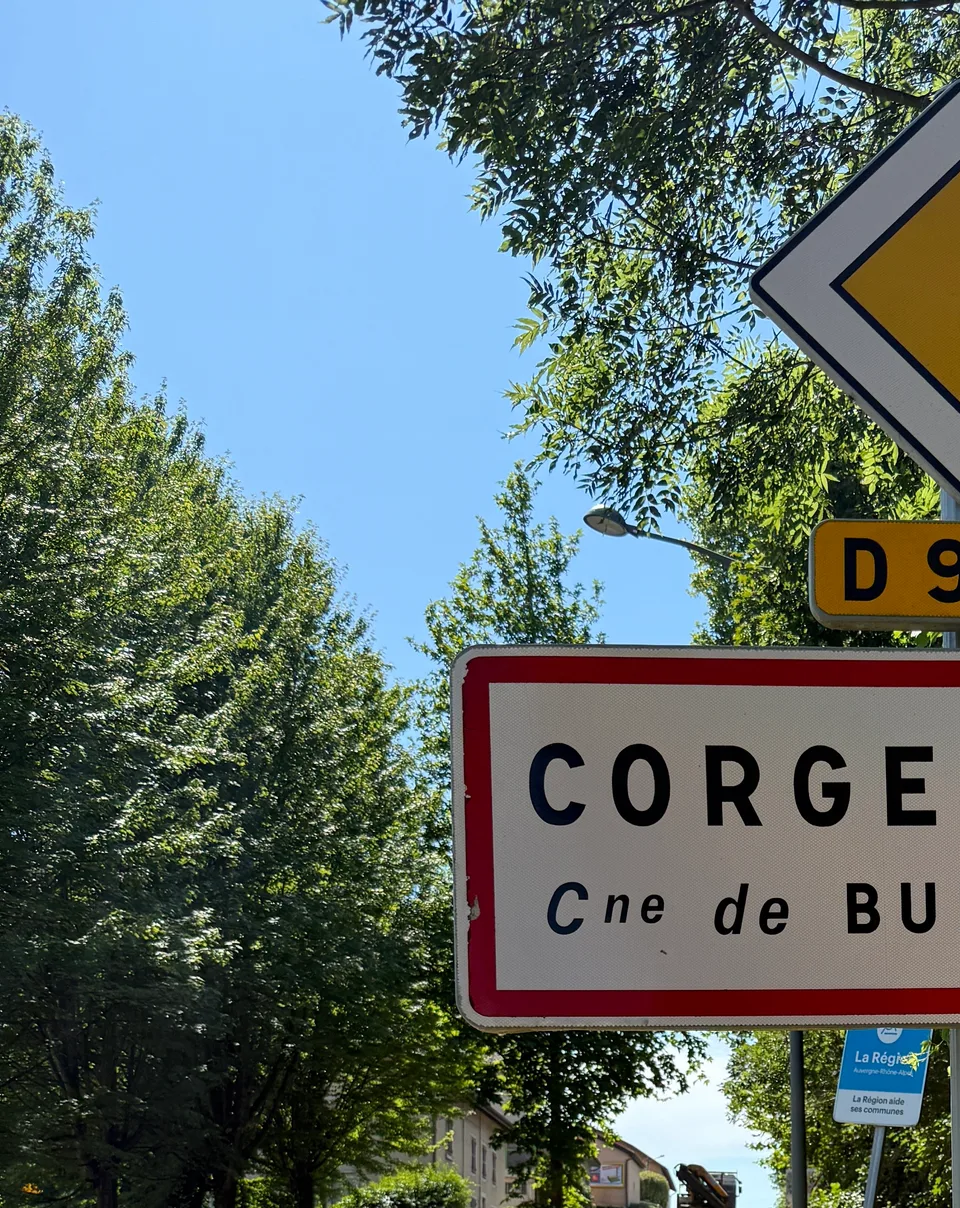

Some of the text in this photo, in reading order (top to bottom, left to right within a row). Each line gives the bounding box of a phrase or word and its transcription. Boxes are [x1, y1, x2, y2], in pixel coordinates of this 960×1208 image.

[844, 537, 888, 602] D
[546, 881, 666, 936] Cne
[714, 883, 790, 936] de
[855, 1051, 914, 1067] La Régi
[852, 1095, 905, 1106] La Région aide
[863, 1107, 904, 1116] communes
